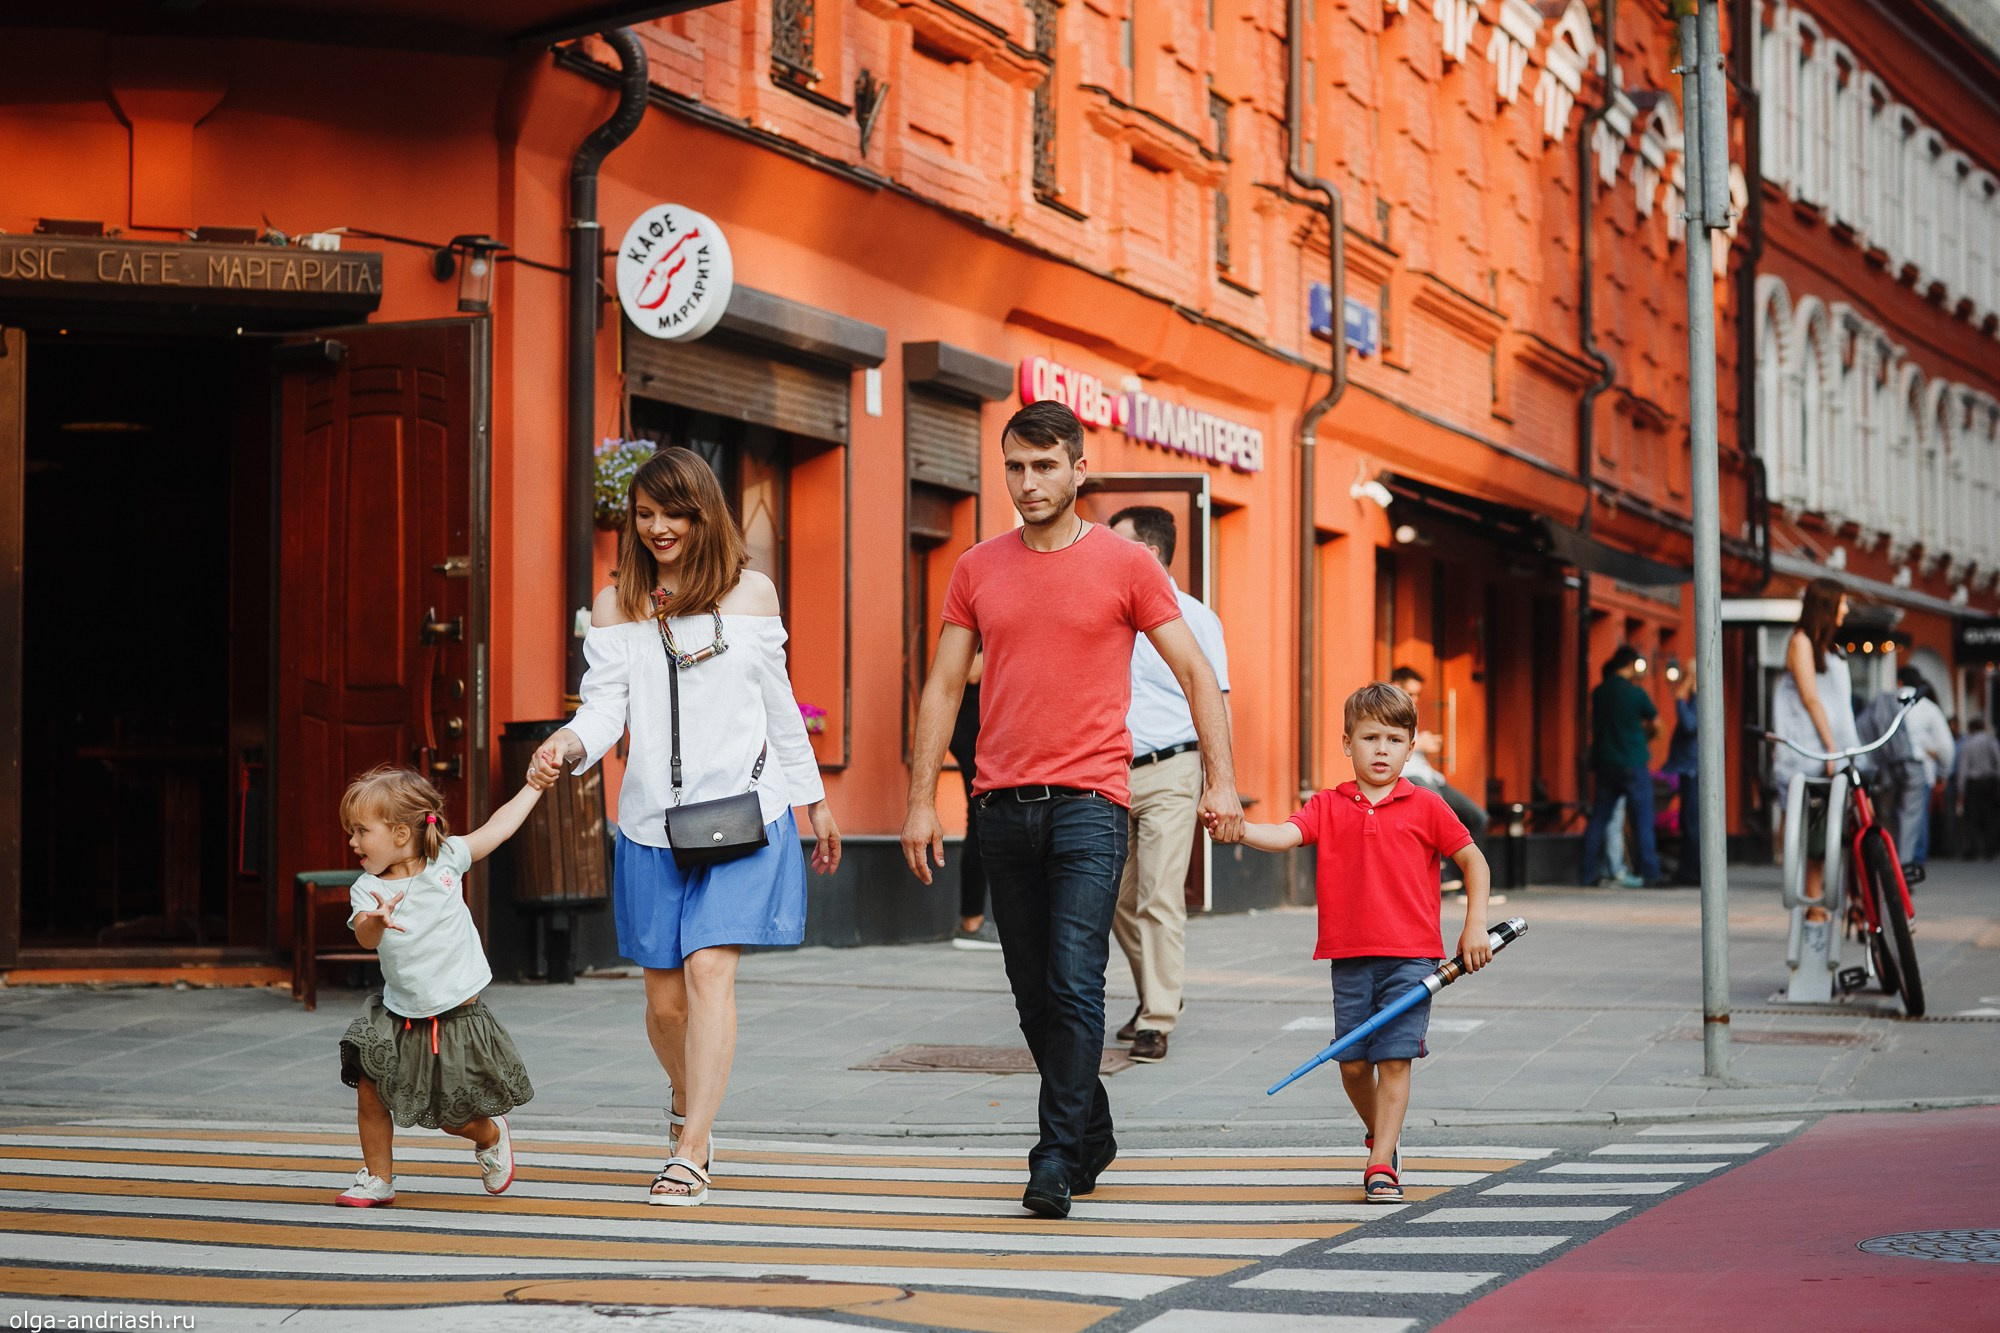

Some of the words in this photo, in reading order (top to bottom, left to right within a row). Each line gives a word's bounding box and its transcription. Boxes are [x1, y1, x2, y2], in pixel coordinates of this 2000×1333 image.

[98, 251, 181, 285] CAFE
[208, 255, 375, 293] МАРГАРИТА
[627, 213, 676, 264] КАФЕ
[658, 245, 710, 329] МАРГАРИТА
[1026, 356, 1112, 428] ОБУВЬ
[1130, 390, 1263, 472] ГАЛАНТЕРЕЯ
